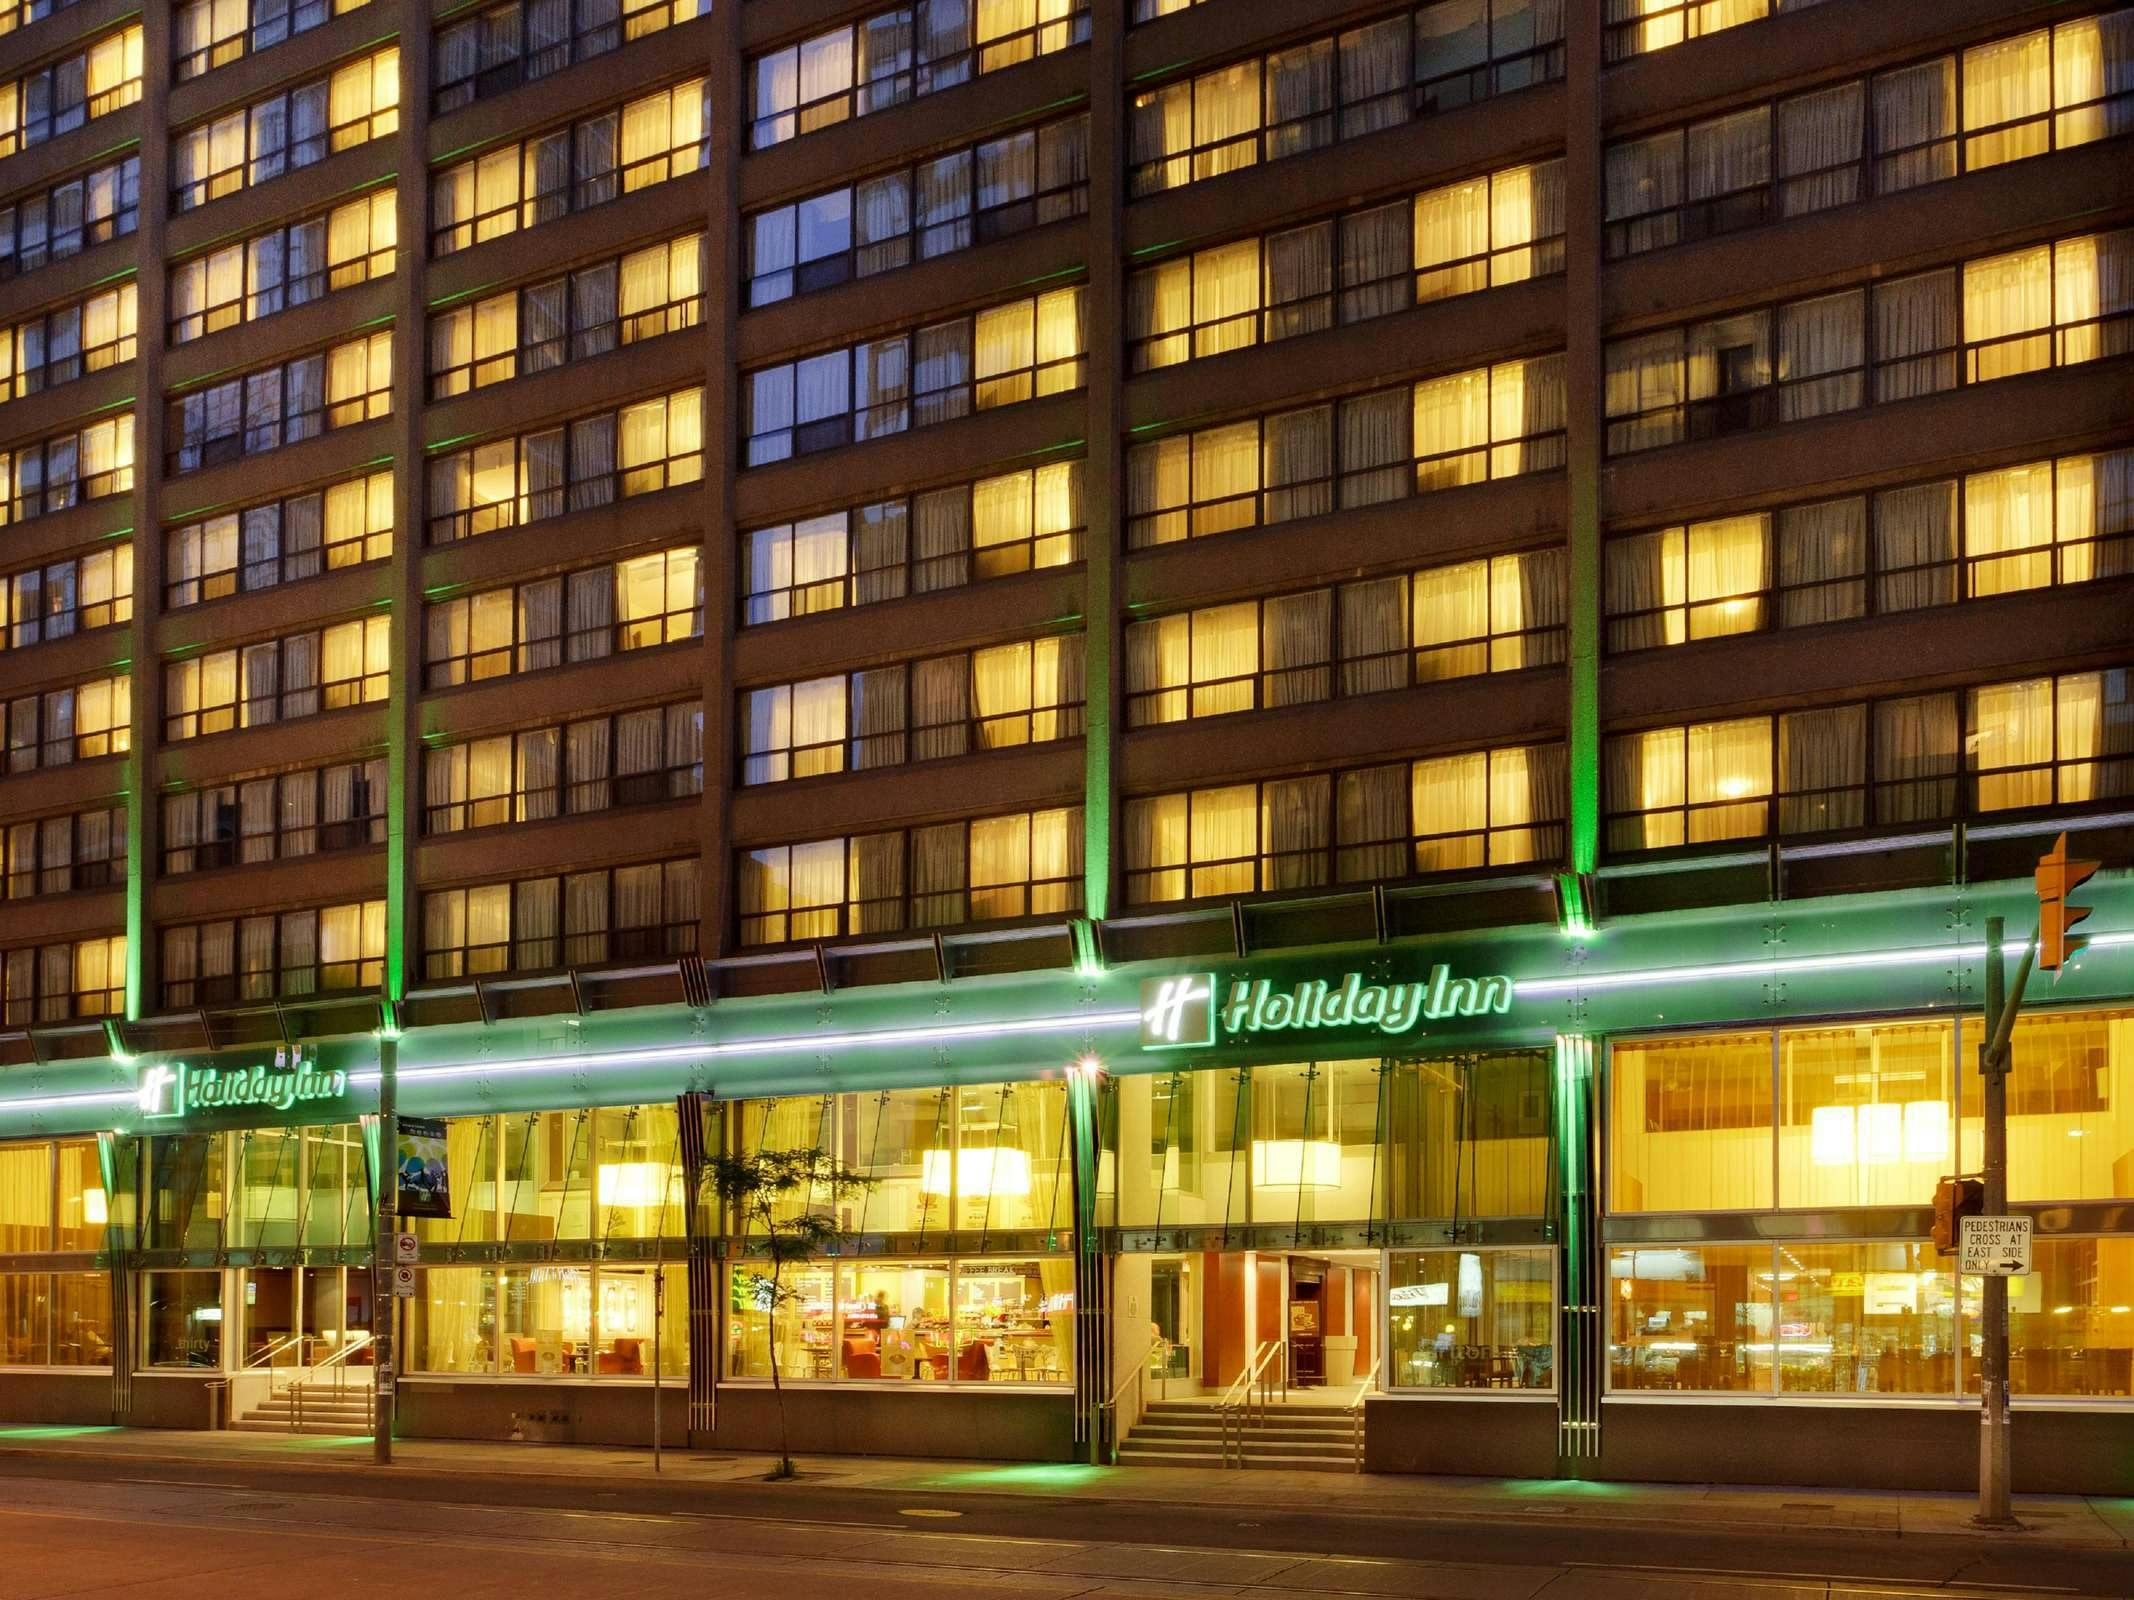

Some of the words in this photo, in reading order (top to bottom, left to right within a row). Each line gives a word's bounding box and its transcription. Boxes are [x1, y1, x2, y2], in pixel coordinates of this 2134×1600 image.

[1222, 973, 1427, 1034] Holiday
[1424, 964, 1512, 1019] Inn
[185, 1065, 296, 1110] Holiday
[293, 1061, 345, 1099] Inn
[1964, 1220, 2028, 1232] PEDESTRIANS
[1970, 1234, 2000, 1245] CROSS
[2010, 1234, 2022, 1245] AT
[1968, 1247, 1992, 1258] EAST
[2002, 1247, 2023, 1258] SIDE
[1966, 1260, 1989, 1271] ONLY
